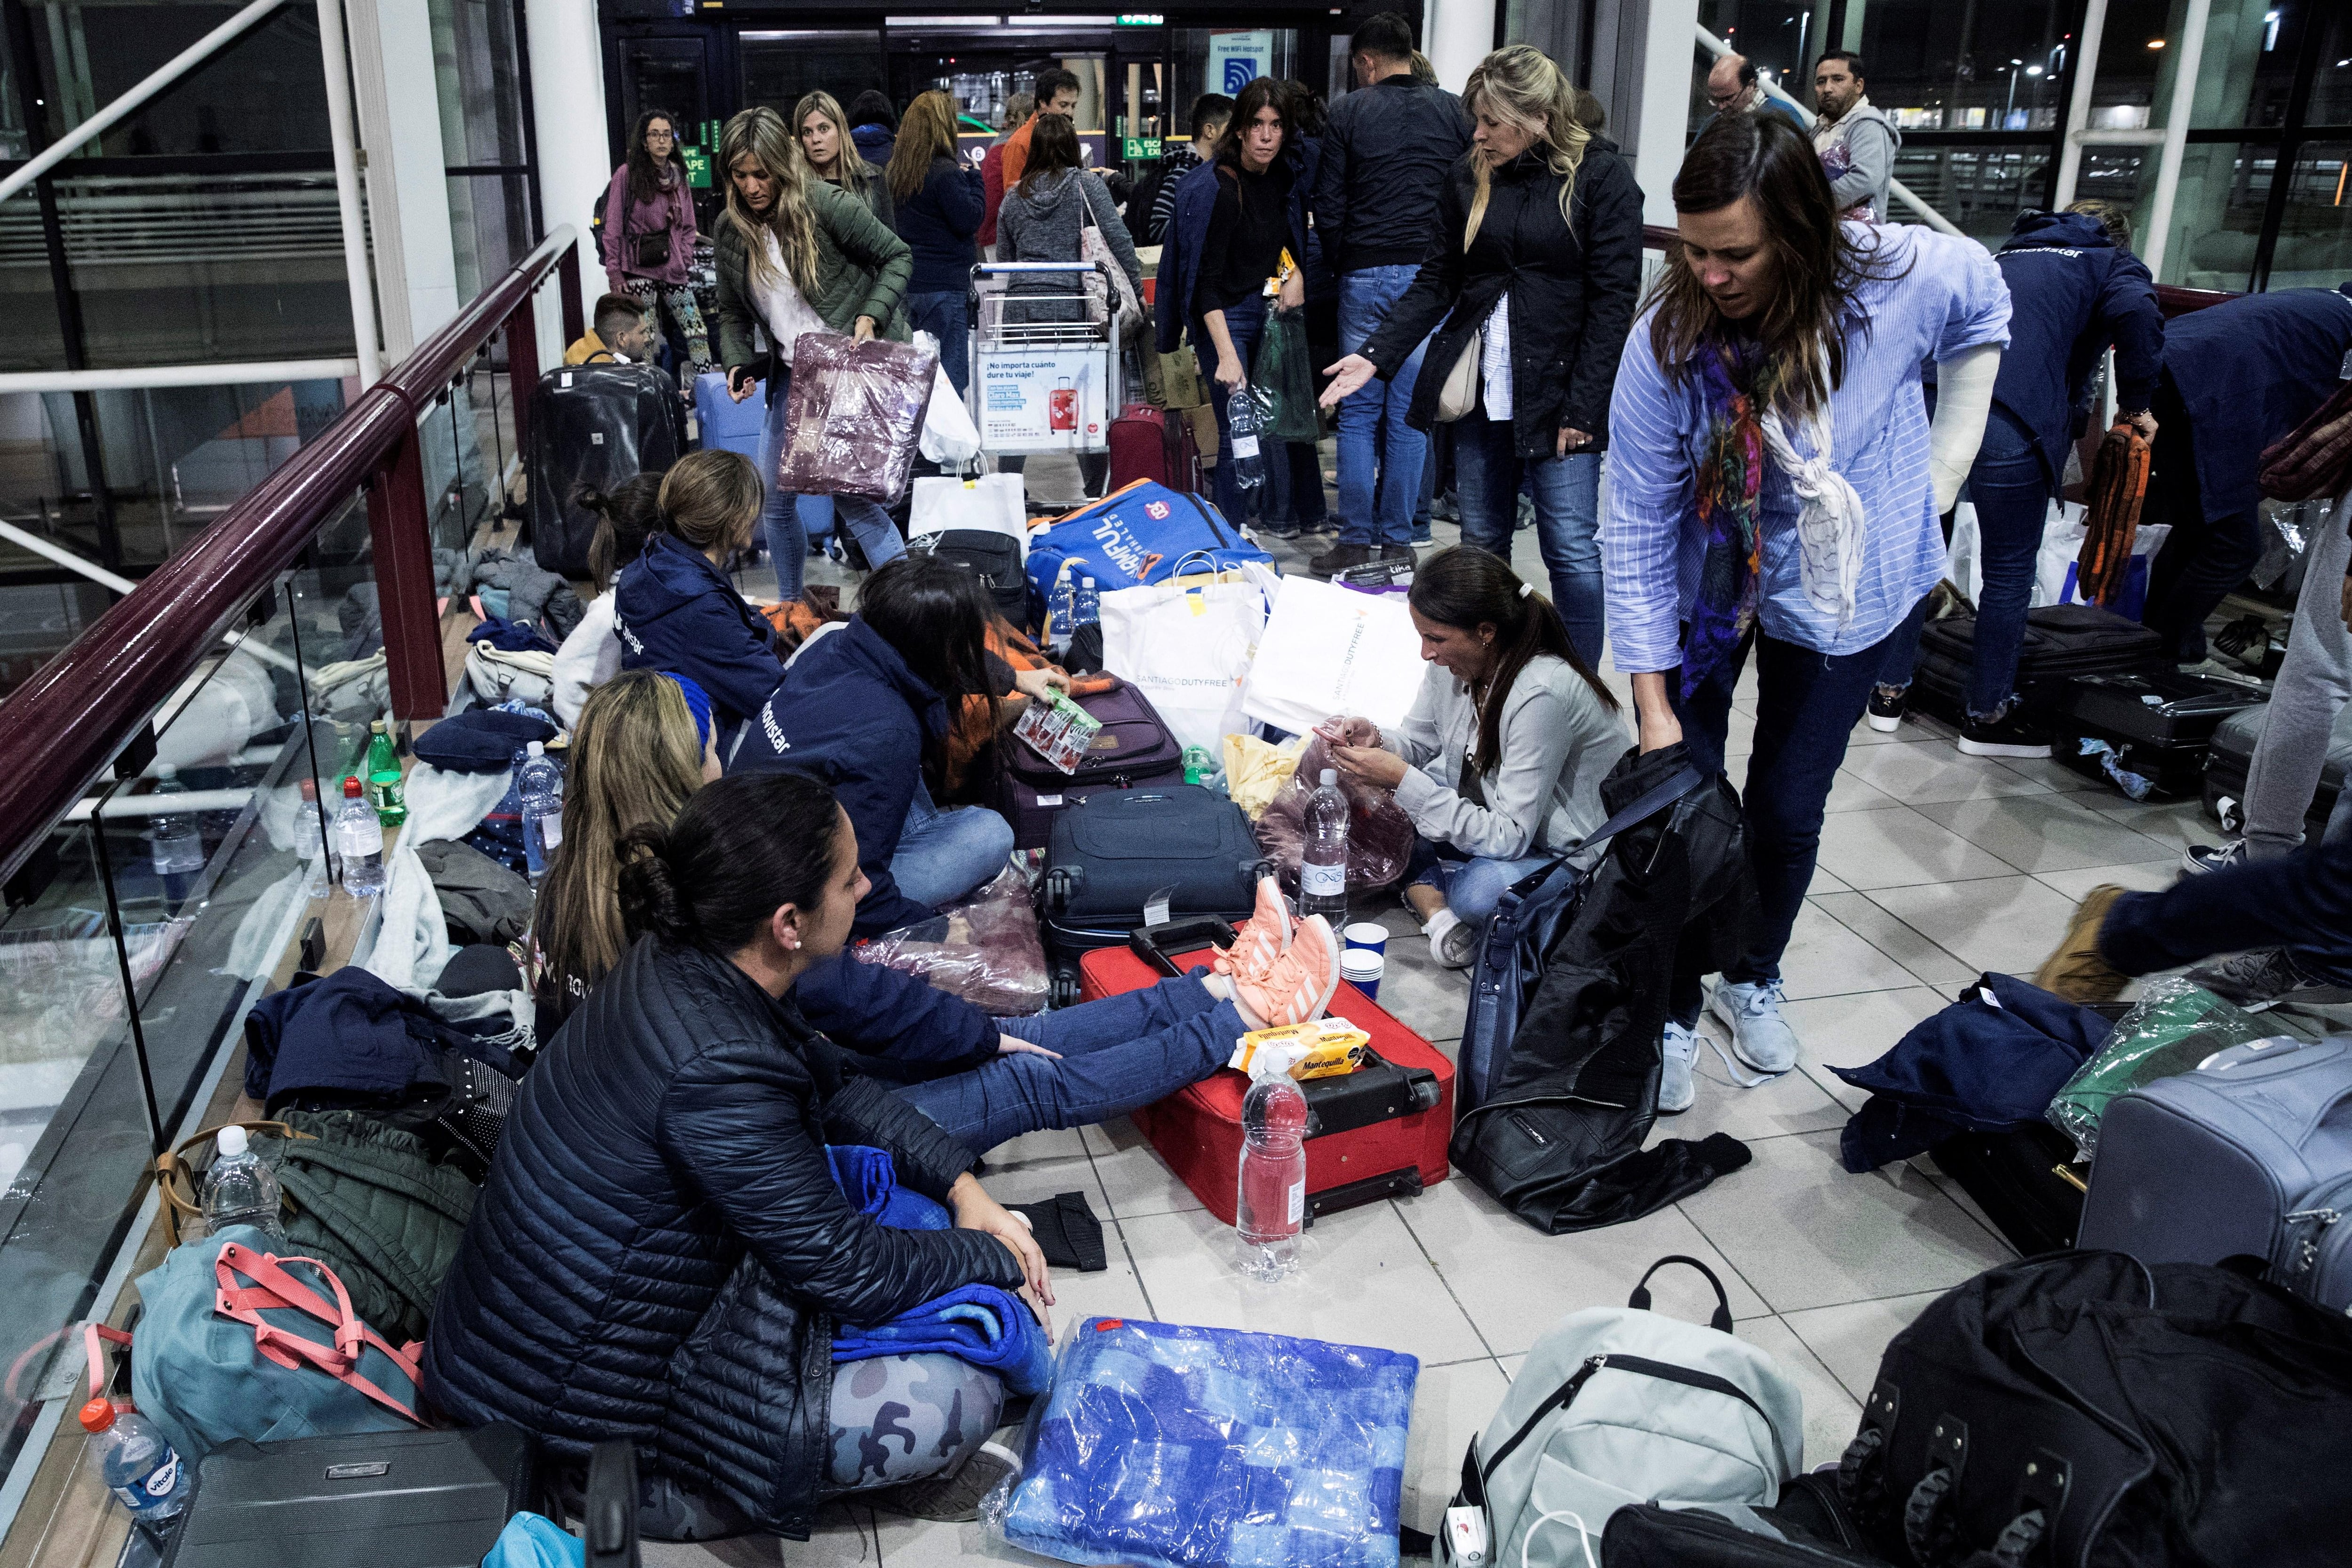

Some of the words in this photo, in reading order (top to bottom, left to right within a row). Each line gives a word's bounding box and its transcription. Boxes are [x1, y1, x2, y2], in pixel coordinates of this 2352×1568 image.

[2010, 247, 2083, 258] movistar
[1389, 564, 1411, 573] tika
[762, 700, 791, 754] movistar
[1258, 1028, 1299, 1039] Mantequilla
[1303, 1057, 1345, 1070] Mantequilla
[150, 1467, 174, 1491] vitale
